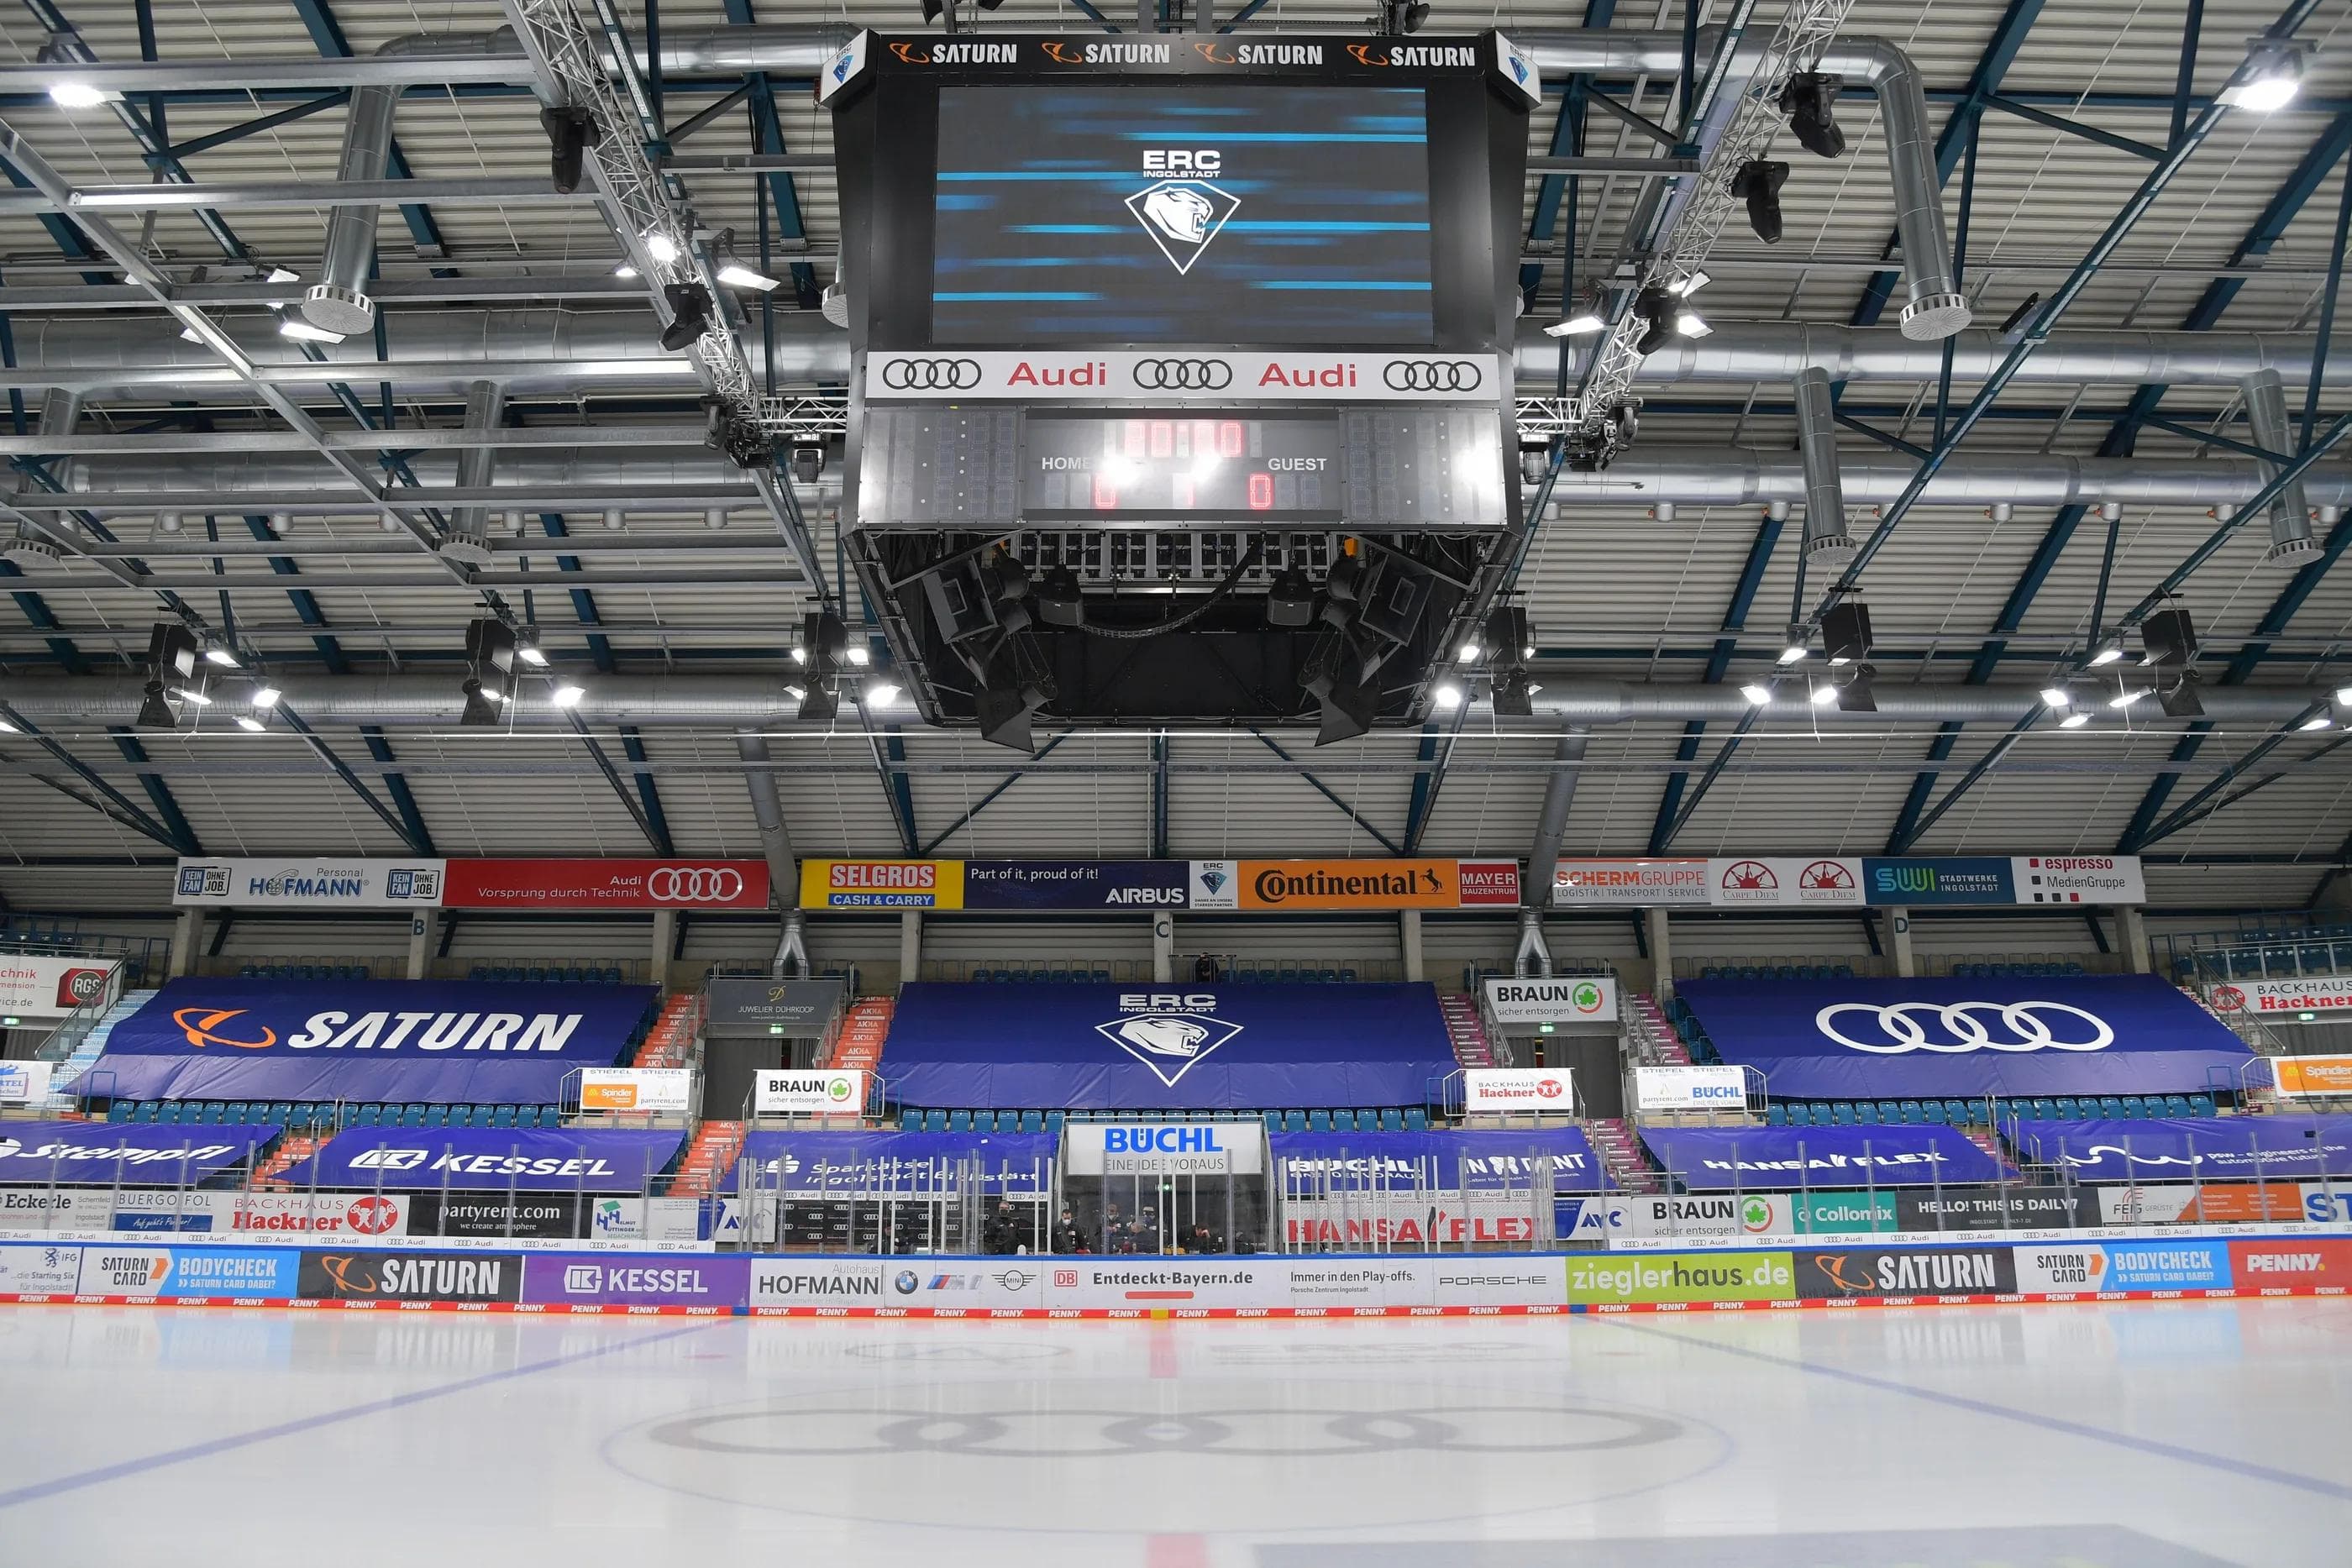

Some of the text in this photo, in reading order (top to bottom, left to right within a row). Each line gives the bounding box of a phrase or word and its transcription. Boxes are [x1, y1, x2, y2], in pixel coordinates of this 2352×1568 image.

[932, 43, 1017, 64] SATURN
[1085, 44, 1170, 65] SATURN
[1238, 45, 1322, 66] SATURN
[1391, 46, 1475, 67] SATURN
[1143, 150, 1221, 170] ERC
[1008, 361, 1106, 386] Audi
[1258, 363, 1357, 388] Audi
[1268, 458, 1326, 471] GUEST
[1250, 472, 1272, 508] 0
[2045, 857, 2113, 871] espresso
[183, 870, 202, 881] KEIN
[207, 871, 225, 881] OHNE
[317, 868, 363, 877] Personal
[393, 873, 410, 883] KEIN
[415, 873, 433, 884] OHNE
[832, 865, 934, 887] SELGROS
[971, 868, 1099, 882] Part of it, proud of it!
[1462, 873, 1515, 884] MAYER
[1940, 874, 1998, 883] STADTWERKE
[181, 881, 202, 892] FAN
[205, 882, 225, 892] JOB.
[611, 875, 642, 885] Audi
[1255, 868, 1418, 903] Continental
[2046, 875, 2125, 889] MedienGruppe
[249, 878, 362, 897] HOFMANN
[391, 884, 409, 894] FAN
[412, 884, 433, 894] JOB.
[478, 888, 640, 899] Vorsprung durch Technik
[1557, 888, 1705, 897] LOGISTIK TRANSPORT SERVICE
[833, 894, 931, 905] CASH & CARRY
[1105, 888, 1184, 904] AIRBUS
[412, 919, 424, 936] B
[1155, 920, 1169, 938] C
[1894, 917, 1908, 934] D
[1120, 994, 1216, 1007] ERC
[1498, 985, 1568, 1002] BRAUN
[1498, 1007, 1569, 1017] sicher entsorgen
[287, 1010, 583, 1052] SATURN
[2306, 1066, 2352, 1078] Spindler
[601, 1088, 632, 1098] Spindler
[769, 1080, 825, 1092] BRAUN
[1479, 1088, 1535, 1098] Hackner
[1693, 1087, 1743, 1099] BÜCHL
[790, 1096, 825, 1104] entsorgen
[1105, 1127, 1223, 1152] BÜCHL
[429, 1156, 615, 1176] KESSEL
[1170, 1158, 1224, 1170] VORAUS
[1853, 1151, 1950, 1167] FLEX
[4, 1193, 71, 1209] Eckerle
[234, 1198, 344, 1209] BACKHAUS
[1919, 1200, 1970, 1213] HELLO!
[1972, 1200, 2004, 1212] THIS
[2010, 1199, 2024, 1211] IS
[439, 1203, 560, 1224] partyrent.com
[1652, 1201, 1734, 1219] BRAUN
[1815, 1205, 1893, 1223] Collomix
[232, 1211, 343, 1230] Hackner
[494, 1223, 537, 1232] atmosphere
[1288, 1218, 1534, 1243] HANSA FLEX
[1686, 1224, 1735, 1236] entsorgen
[62, 1253, 77, 1261] IFG
[102, 1257, 149, 1271] SATURN
[2037, 1254, 2084, 1270] SATURN
[2113, 1251, 2212, 1271] BODYCHECK
[2247, 1253, 2326, 1272] PENNY.
[179, 1257, 277, 1277] BODYCHECK
[832, 1263, 879, 1274] Autohaus
[1877, 1254, 1996, 1290] SATURN
[32, 1272, 61, 1281] Starting
[113, 1272, 146, 1286] CARD
[381, 1259, 501, 1294] SATURN
[608, 1268, 708, 1293] KESSEL
[1057, 1273, 1075, 1284] DB
[1093, 1271, 1253, 1287] Entdeckt-Bayern.de
[1290, 1271, 1415, 1284] Immer in den Play-offs.
[1439, 1276, 1547, 1286] PORSCHE
[1572, 1259, 1789, 1297] zieglerhaus.de
[2052, 1269, 2086, 1283] CARD
[2129, 1271, 2214, 1282] SATURN CARD DABEI?
[190, 1279, 276, 1289] SATURN CARD DABEI?
[759, 1275, 879, 1294] HOFMANN
[126, 1296, 157, 1304] PENNY.
[2152, 1290, 2183, 1298] PENNY.
[1354, 1308, 1386, 1316] PENNY.
